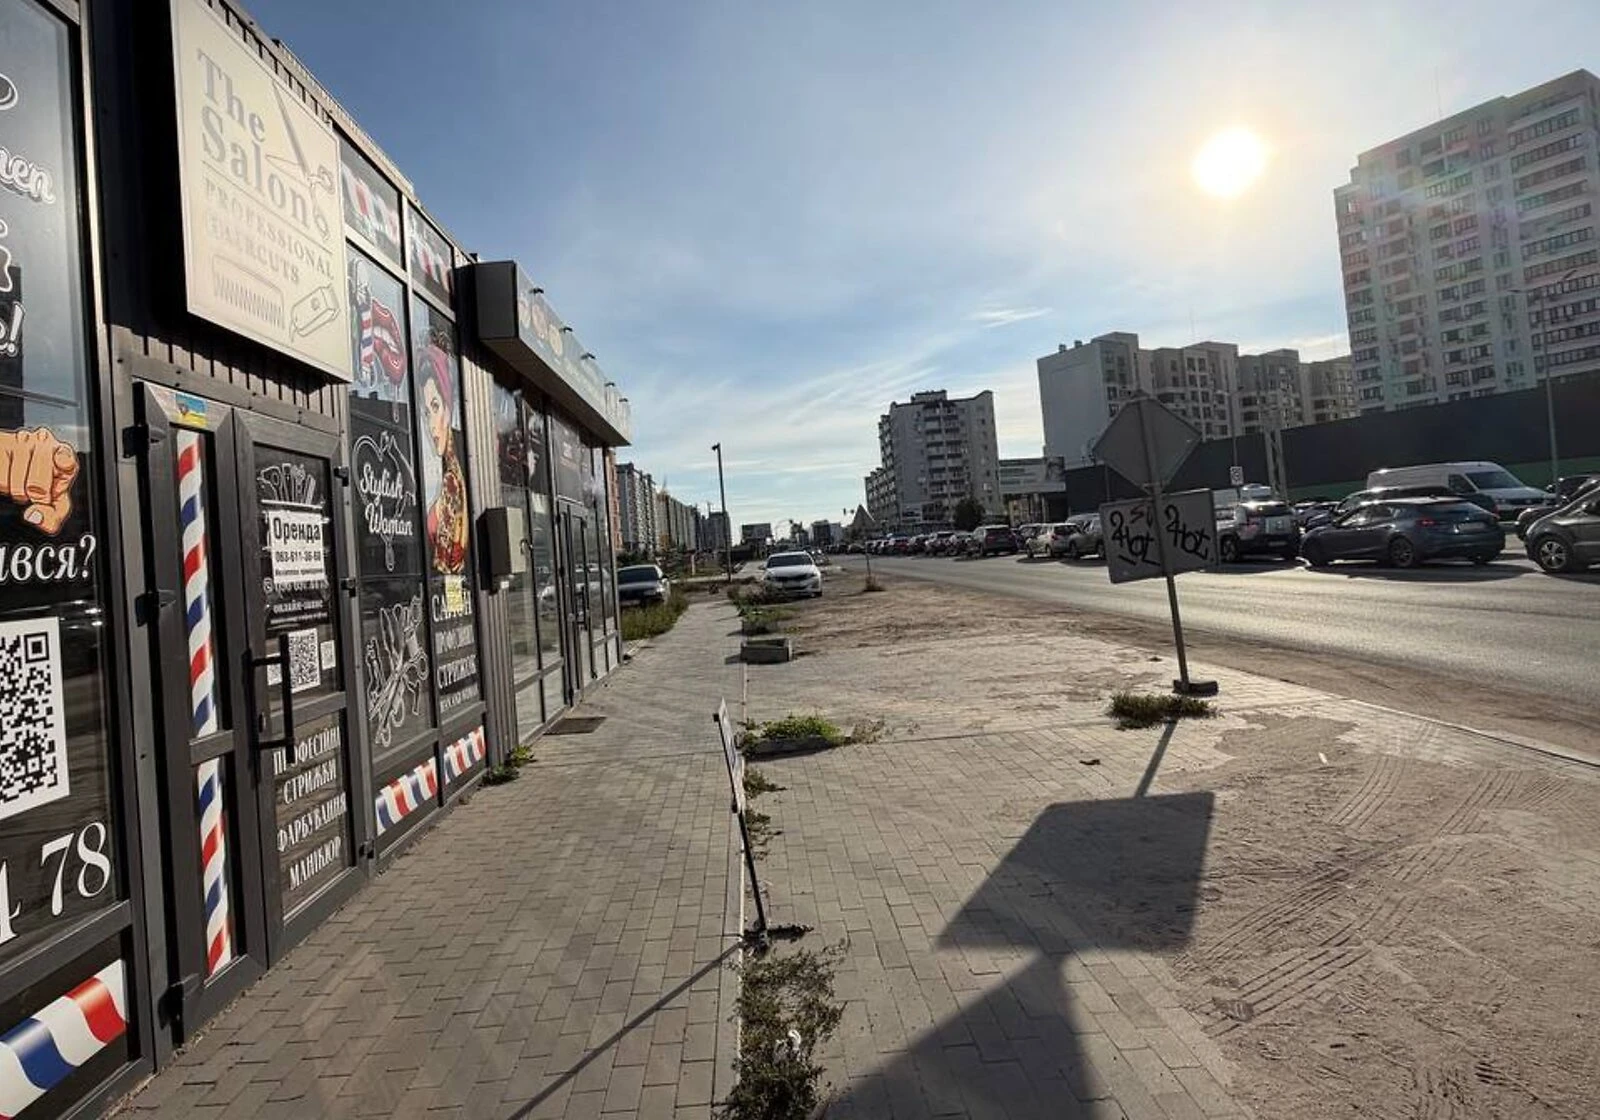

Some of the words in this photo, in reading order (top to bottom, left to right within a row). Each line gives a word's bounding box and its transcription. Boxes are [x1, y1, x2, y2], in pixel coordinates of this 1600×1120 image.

[197, 48, 267, 143] The
[201, 104, 310, 231] Salon
[205, 176, 334, 281] PROFESSIONAL
[206, 210, 300, 284] HAIRCUTS
[360, 462, 403, 506] Stylish
[273, 516, 321, 544] Оренда
[283, 757, 337, 805] СТРИЖКИ
[276, 792, 348, 852] ФАРБУВАННЯ
[41, 822, 111, 916] 78
[289, 835, 342, 891] МАНІКЮР
